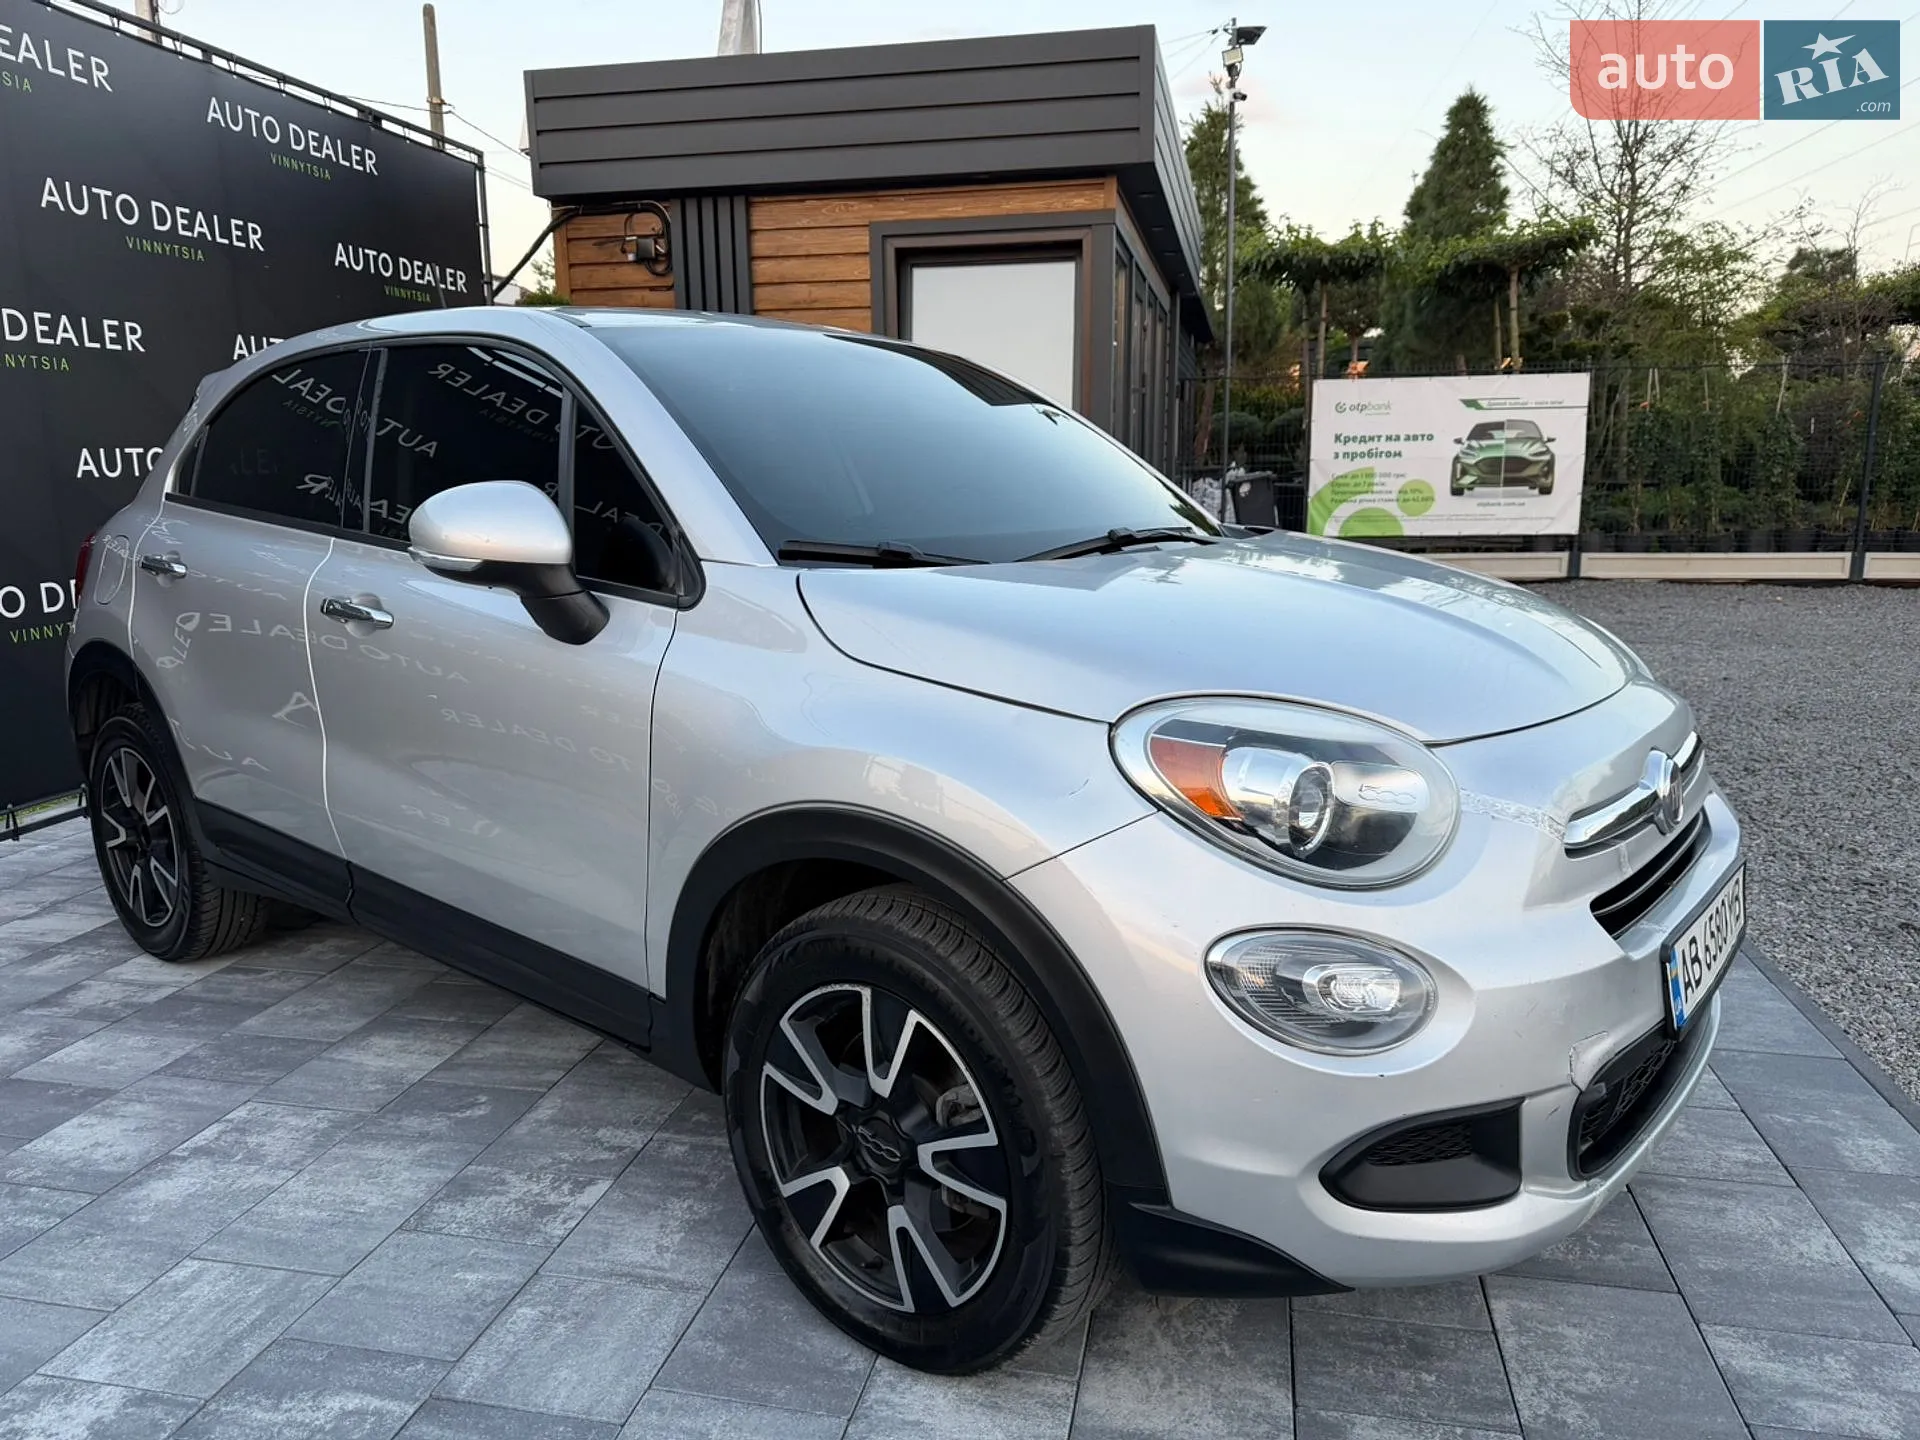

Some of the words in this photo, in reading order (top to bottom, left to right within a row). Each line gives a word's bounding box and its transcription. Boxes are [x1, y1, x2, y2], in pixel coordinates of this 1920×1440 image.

[207, 97, 281, 145] AUTO
[288, 122, 379, 176] DEALER
[270, 152, 331, 180] VINNYTSIA
[41, 177, 140, 226] AUTO
[151, 200, 264, 251] DEALER
[125, 236, 205, 262] VINNYTSIA
[334, 242, 393, 278] AUTO
[399, 257, 468, 293] DEALER
[384, 284, 432, 304] VINNYTSIA
[1, 308, 146, 352] DEALER
[233, 333, 285, 361] AU
[1349, 400, 1392, 414] otpbank
[1333, 432, 1383, 446] Кредит
[1385, 433, 1401, 443] на
[1403, 432, 1435, 442] авто
[1333, 451, 1340, 460] з
[1342, 447, 1403, 462] пробігом
[1681, 935, 1703, 1003] AB
[1703, 896, 1729, 971] 6580
